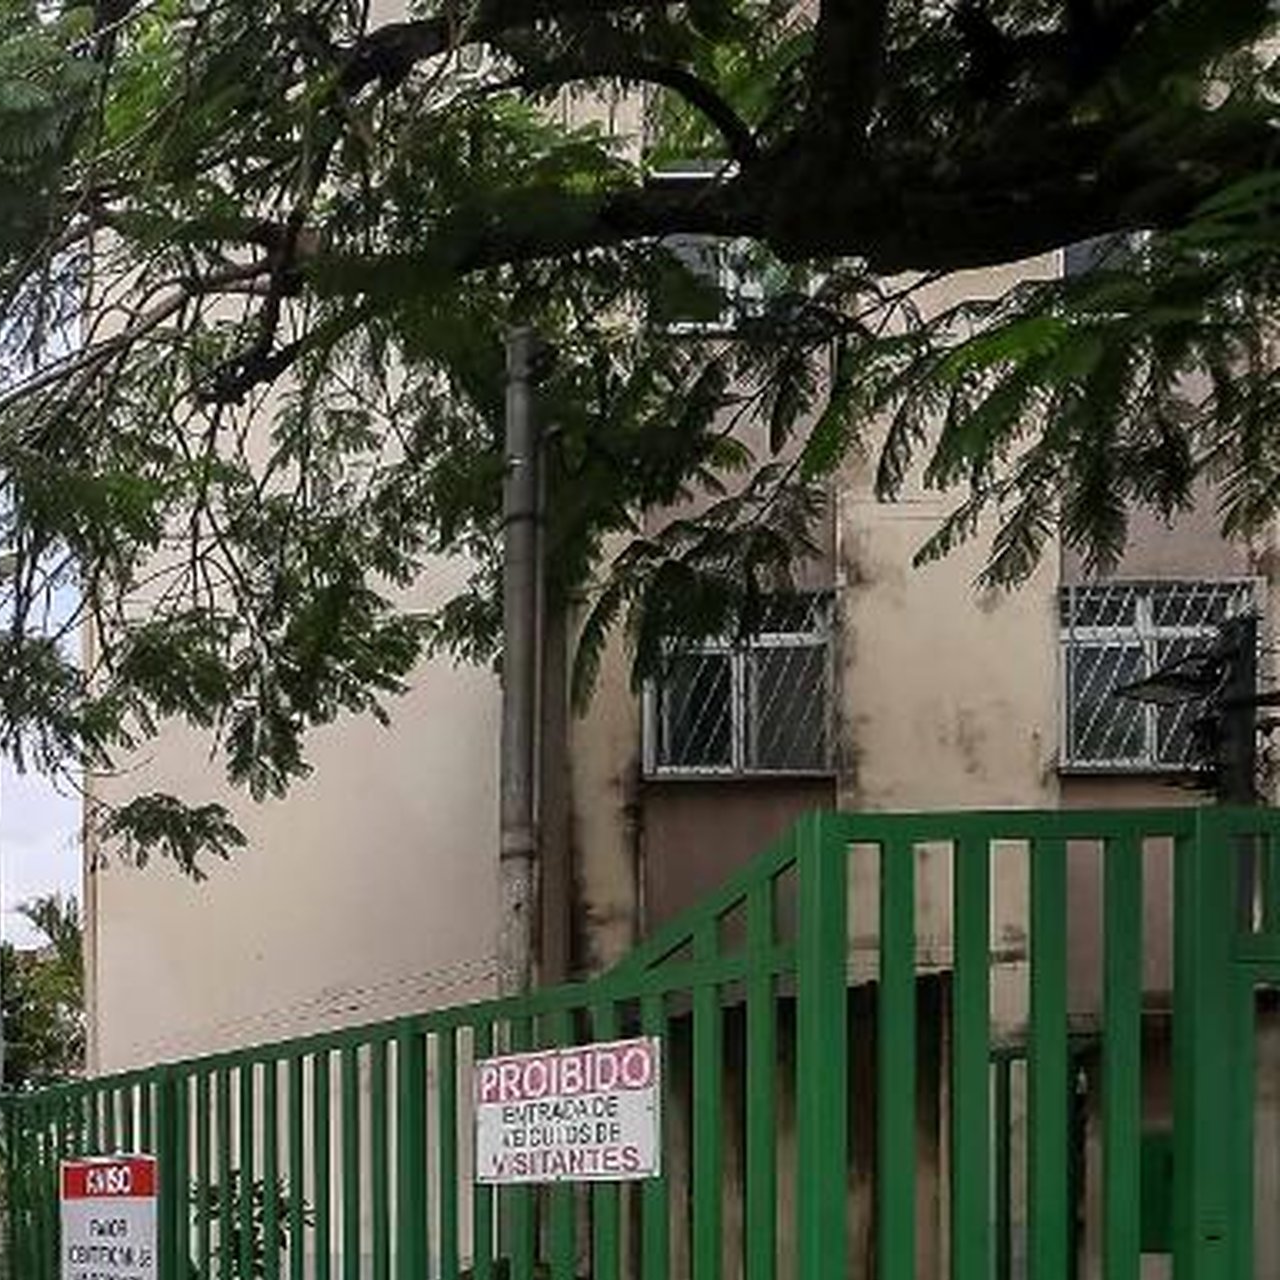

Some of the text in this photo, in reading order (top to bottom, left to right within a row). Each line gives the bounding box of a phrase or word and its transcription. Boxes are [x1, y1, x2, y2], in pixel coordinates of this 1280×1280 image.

[481, 1048, 651, 1101] PROIBIDO
[502, 1096, 619, 1125] ENTRADA DE
[596, 1121, 621, 1144] DE
[492, 1145, 641, 1175] VISITANTES
[85, 1166, 132, 1195] AVISO
